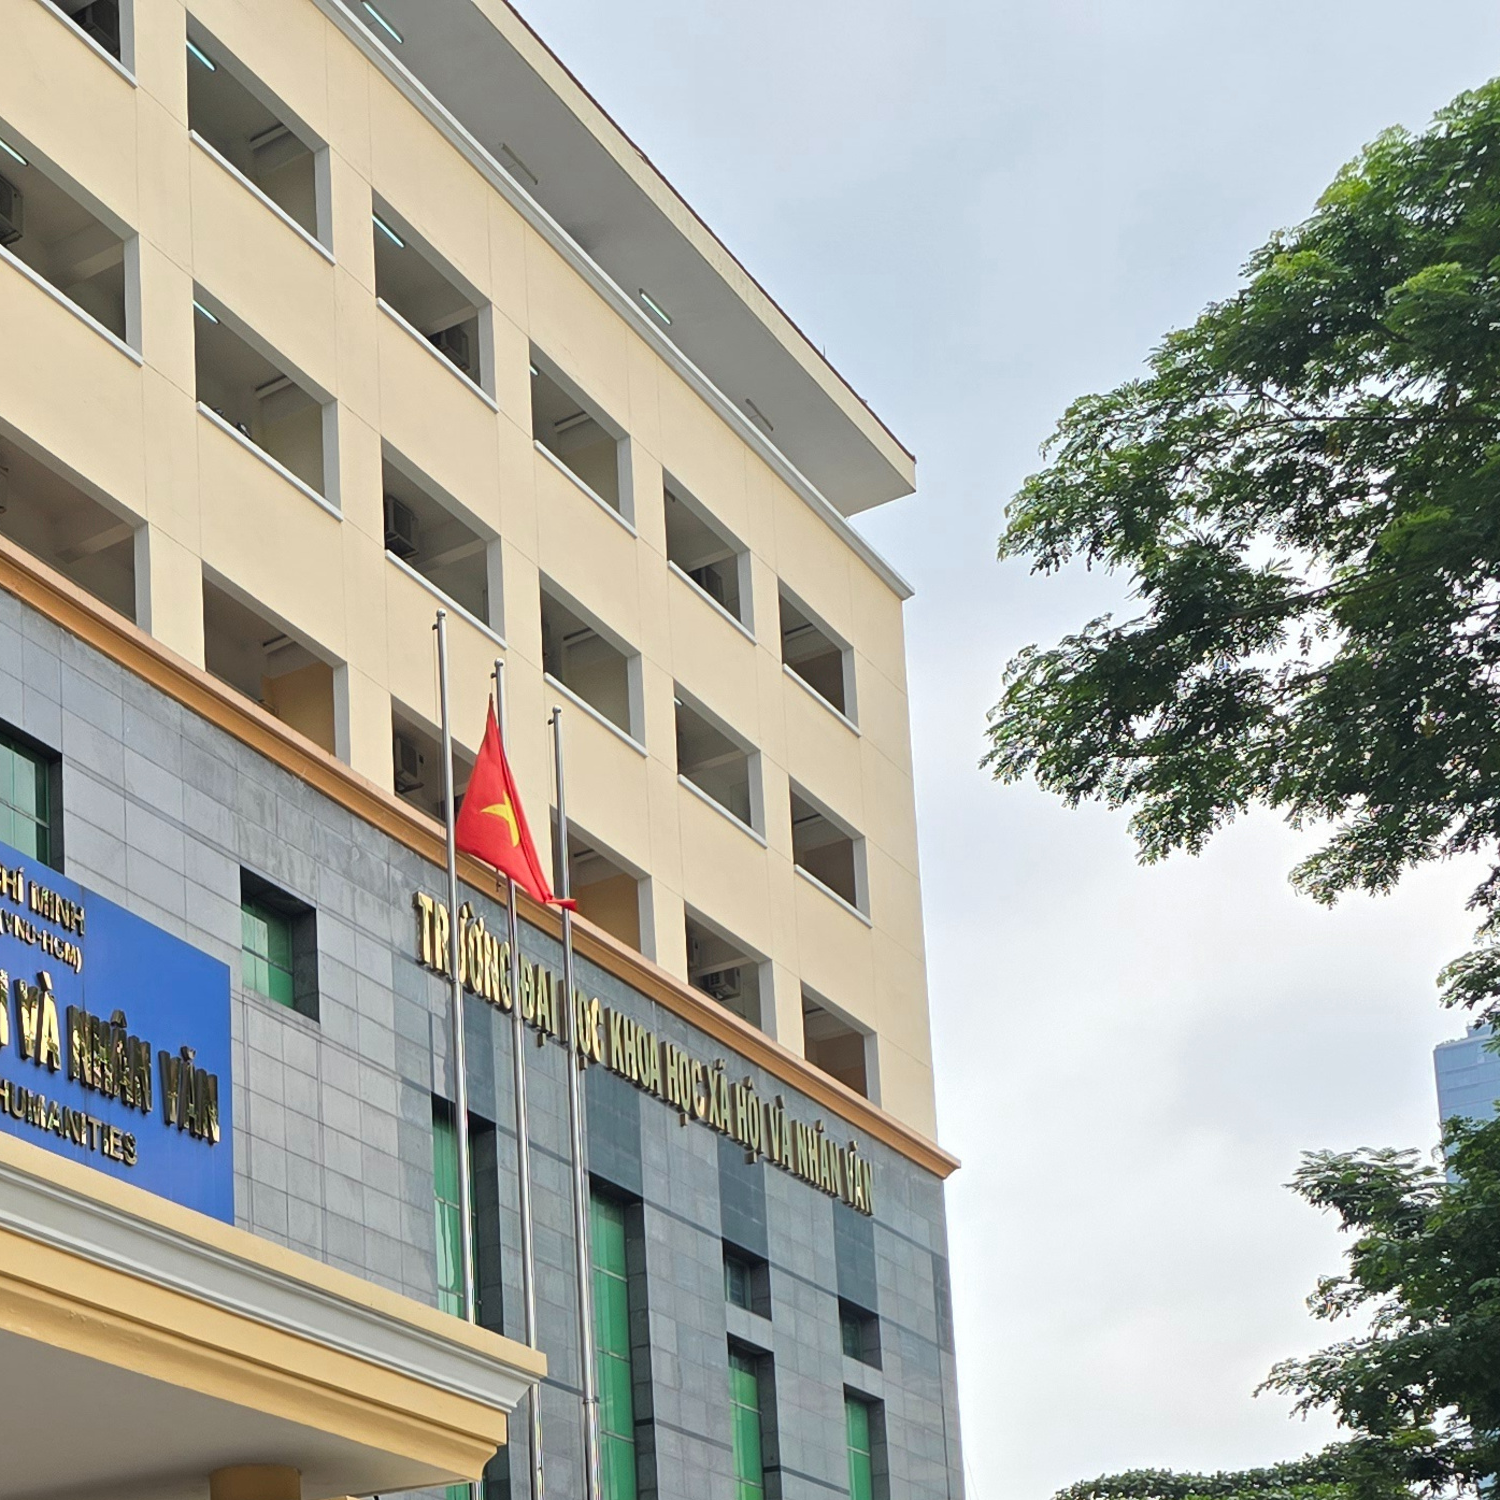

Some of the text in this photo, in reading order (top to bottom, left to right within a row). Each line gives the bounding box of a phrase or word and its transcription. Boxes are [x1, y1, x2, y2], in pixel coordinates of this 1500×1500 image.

[30, 880, 86, 936] MINH
[14, 971, 62, 1071] VÀ
[67, 1009, 152, 1114] NHÂN
[158, 1046, 220, 1145] VĂN
[519, 953, 557, 1048] ĐẠI
[605, 1007, 660, 1096] KHOA
[661, 1040, 705, 1128] HỌC
[702, 1058, 732, 1135] XÃ
[731, 1075, 769, 1165] HỘI
[764, 1094, 792, 1170] VÀ
[791, 1119, 842, 1197] NHÂN
[839, 1140, 873, 1216] VĂN
